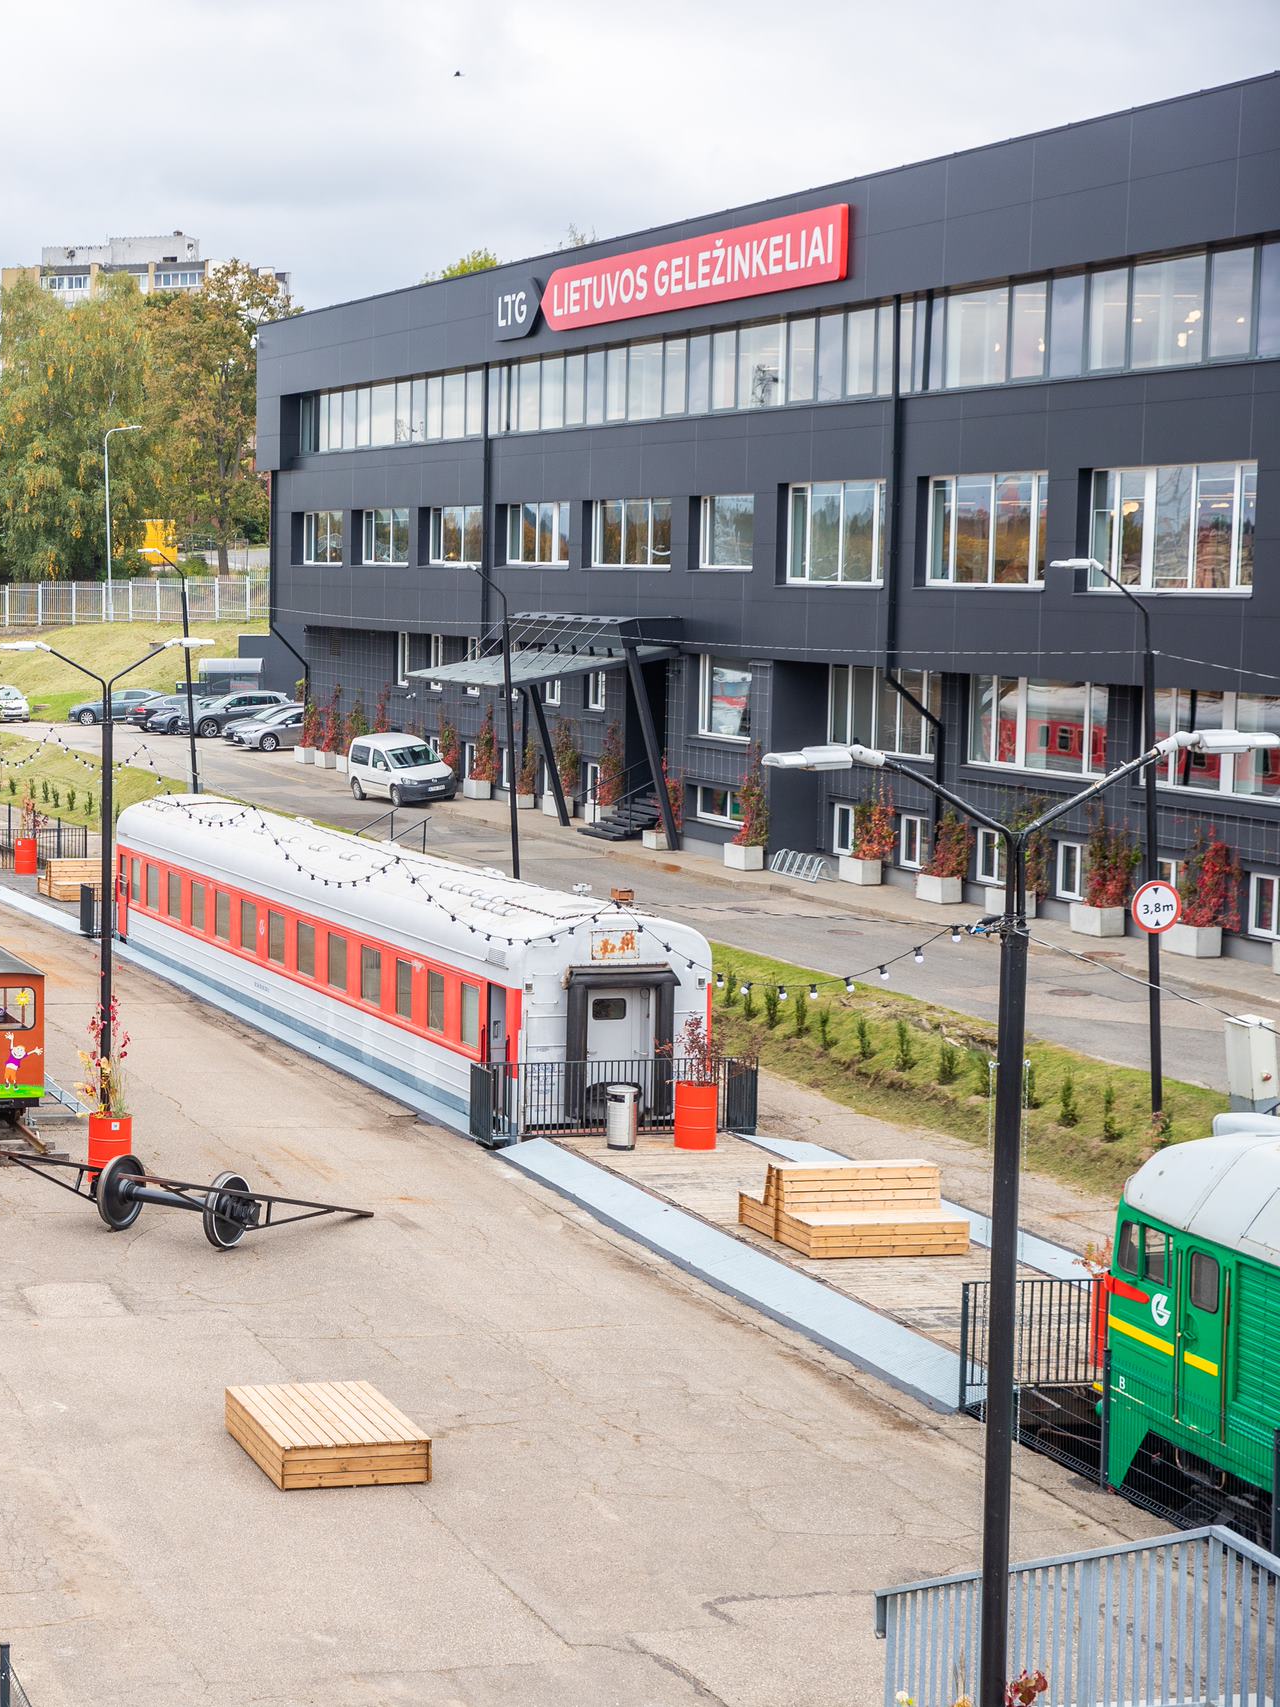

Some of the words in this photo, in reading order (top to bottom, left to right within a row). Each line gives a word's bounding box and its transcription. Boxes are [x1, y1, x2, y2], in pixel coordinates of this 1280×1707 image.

[552, 264, 648, 318] LIETUVOS
[654, 223, 835, 297] GELEŽINKELIAI
[497, 291, 527, 328] LTG
